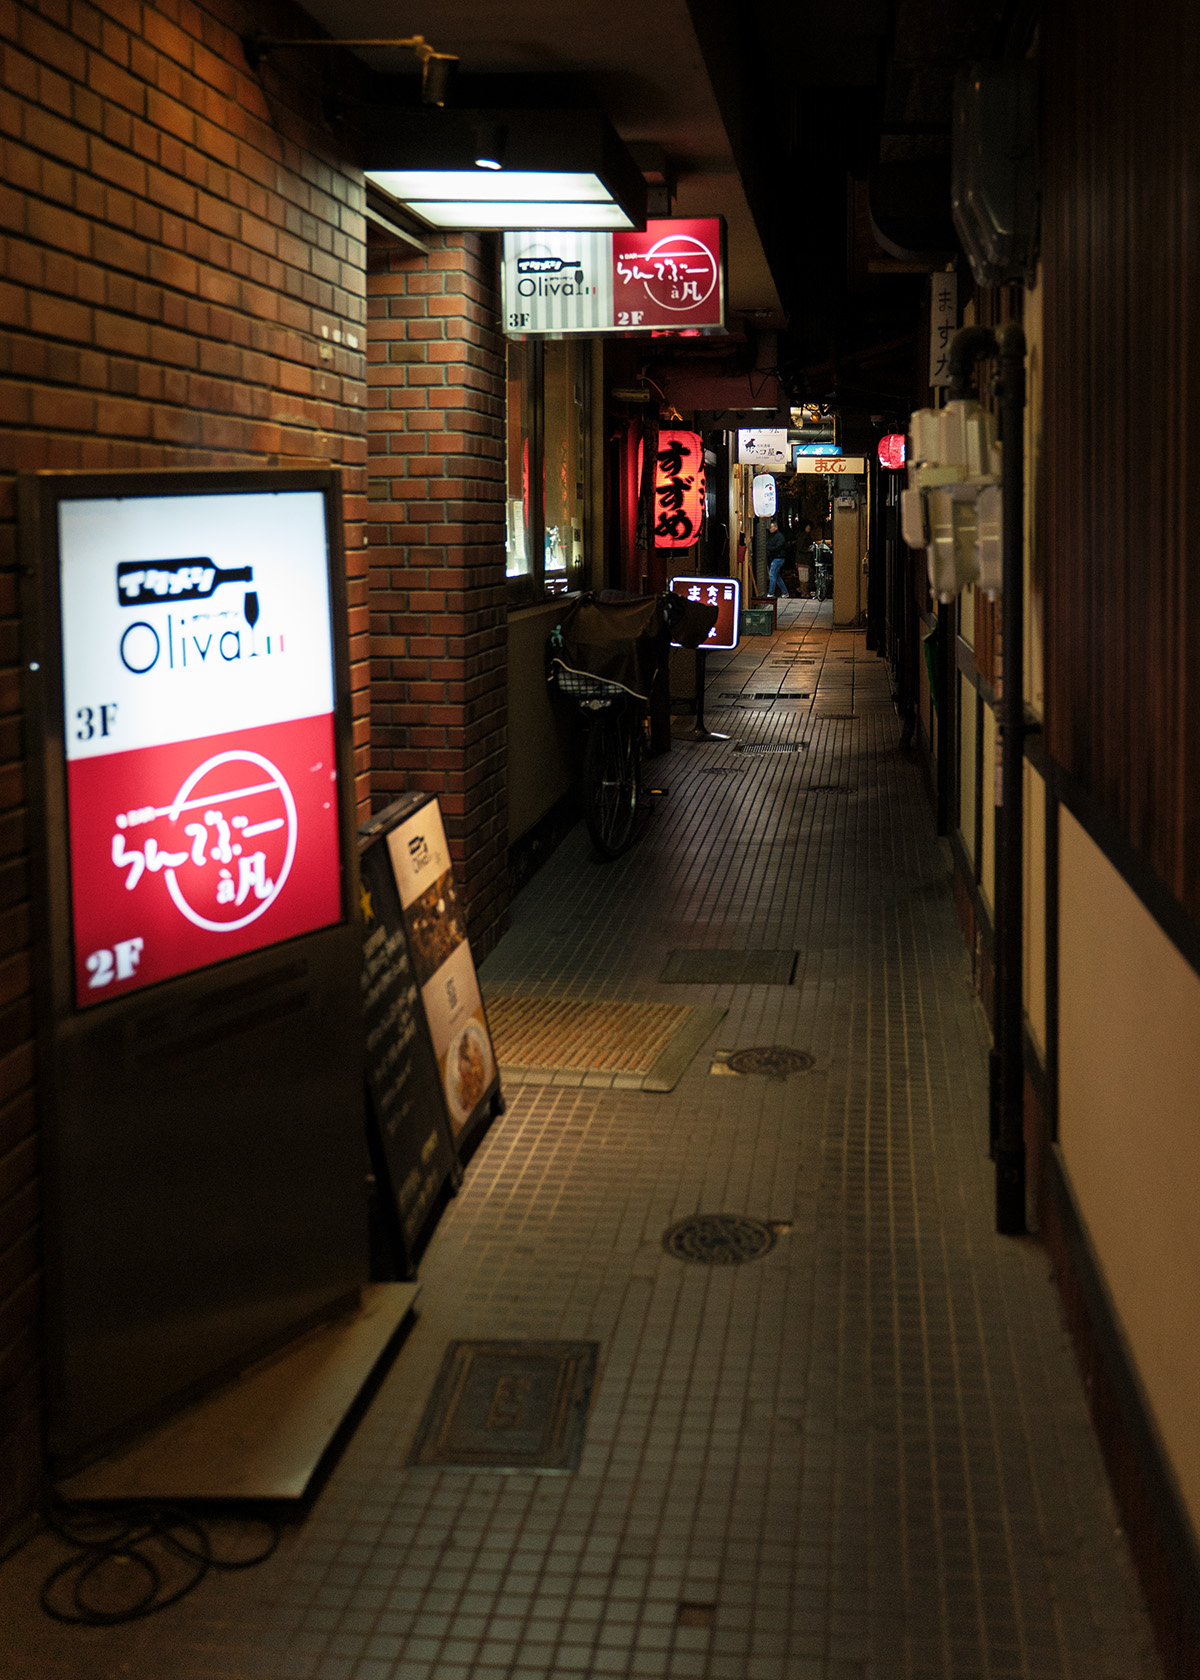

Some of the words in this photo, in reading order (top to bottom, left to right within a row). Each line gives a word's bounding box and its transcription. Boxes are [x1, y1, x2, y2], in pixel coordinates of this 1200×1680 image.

[517, 276, 574, 297] Oliva
[509, 313, 530, 327] 3F
[617, 310, 644, 325] 2F
[654, 441, 694, 540] すずめ
[119, 613, 241, 674] Oliva
[75, 702, 119, 742] 3F
[85, 936, 145, 990] 2F
